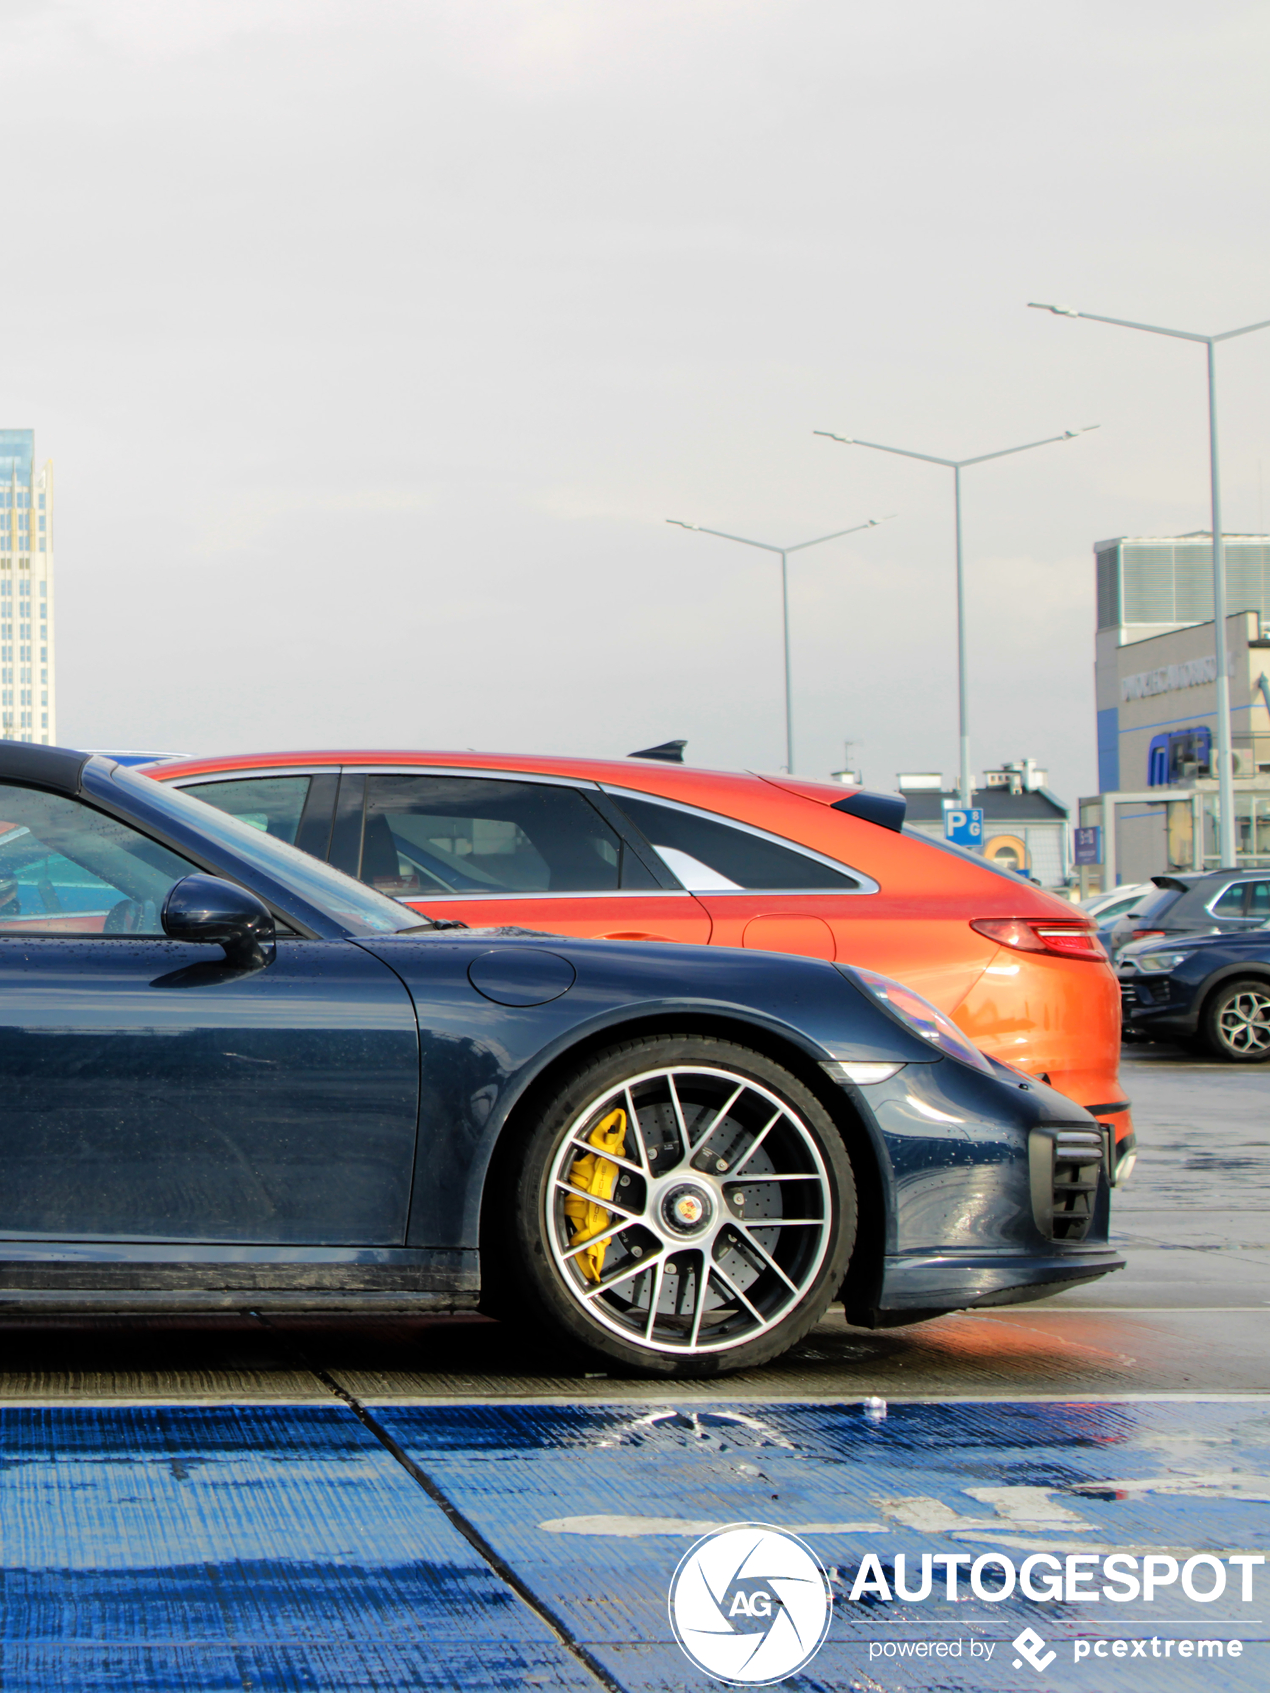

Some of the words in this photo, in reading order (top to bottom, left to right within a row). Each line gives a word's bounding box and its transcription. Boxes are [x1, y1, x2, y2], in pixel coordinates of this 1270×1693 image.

[947, 811, 967, 836] P
[970, 822, 981, 836] G
[593, 1165, 607, 1222] POSCHE
